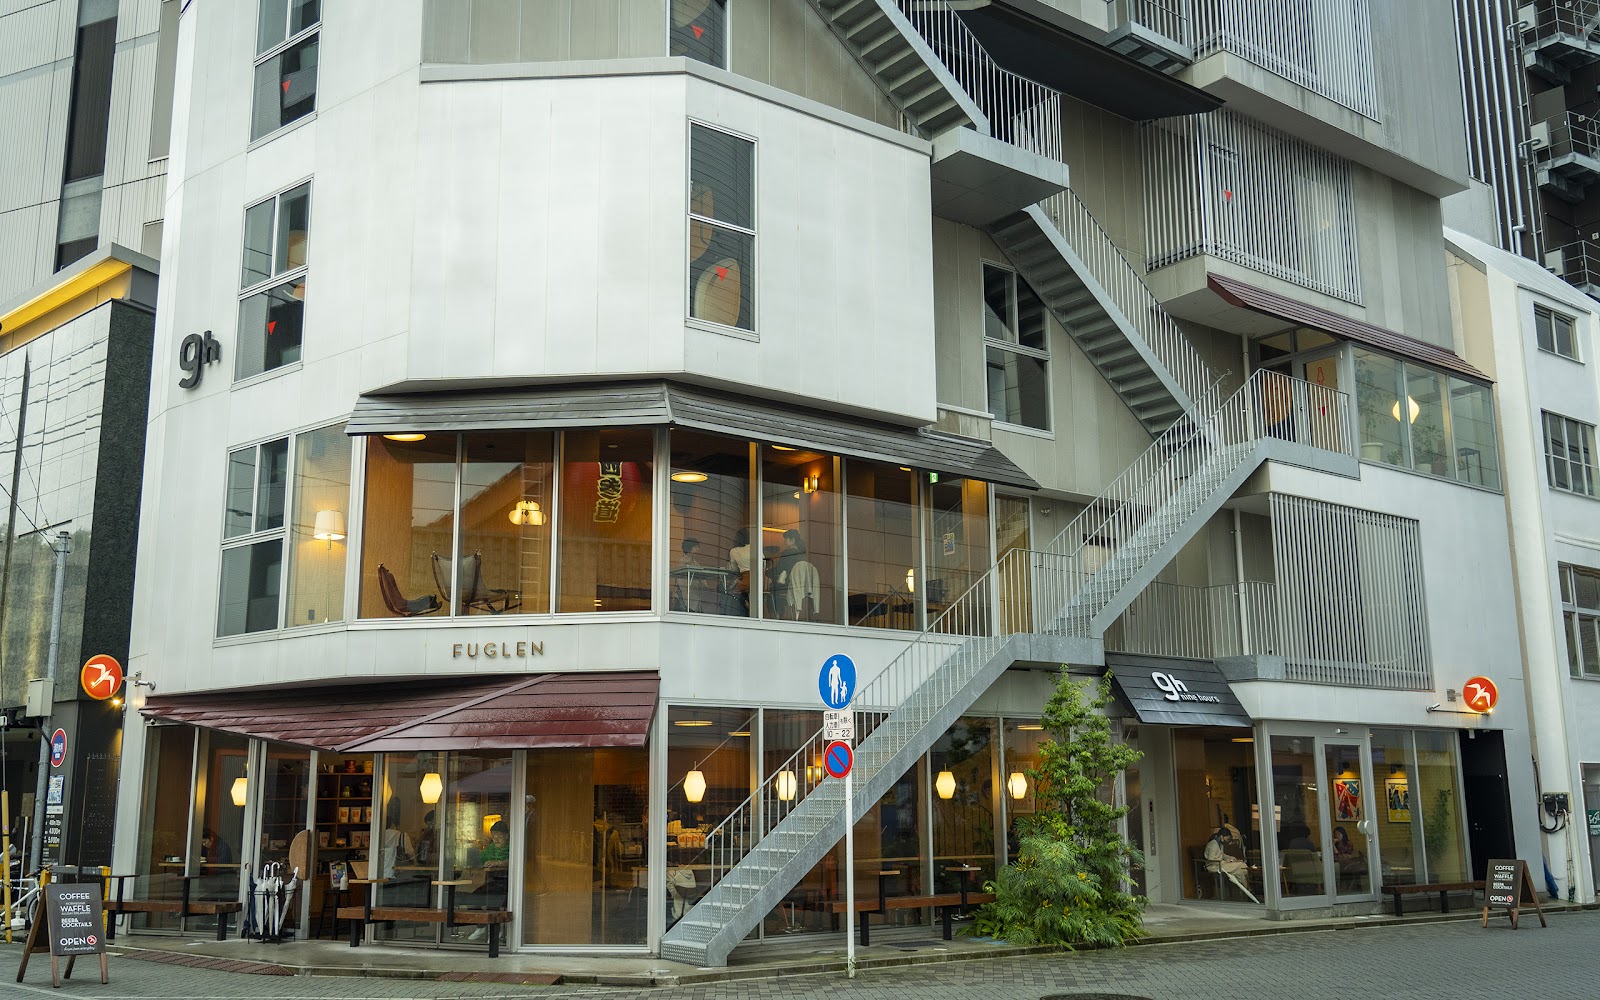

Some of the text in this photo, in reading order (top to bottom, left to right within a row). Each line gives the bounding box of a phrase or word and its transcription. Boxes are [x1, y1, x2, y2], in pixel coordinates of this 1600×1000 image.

[453, 641, 543, 658] FUGLEN
[1180, 692, 1220, 703] nine hours
[827, 730, 833, 738] 10
[841, 729, 850, 738] 22
[59, 892, 90, 900] COFFEE
[60, 904, 90, 912] WAFFLE
[60, 937, 86, 946] OPEN
